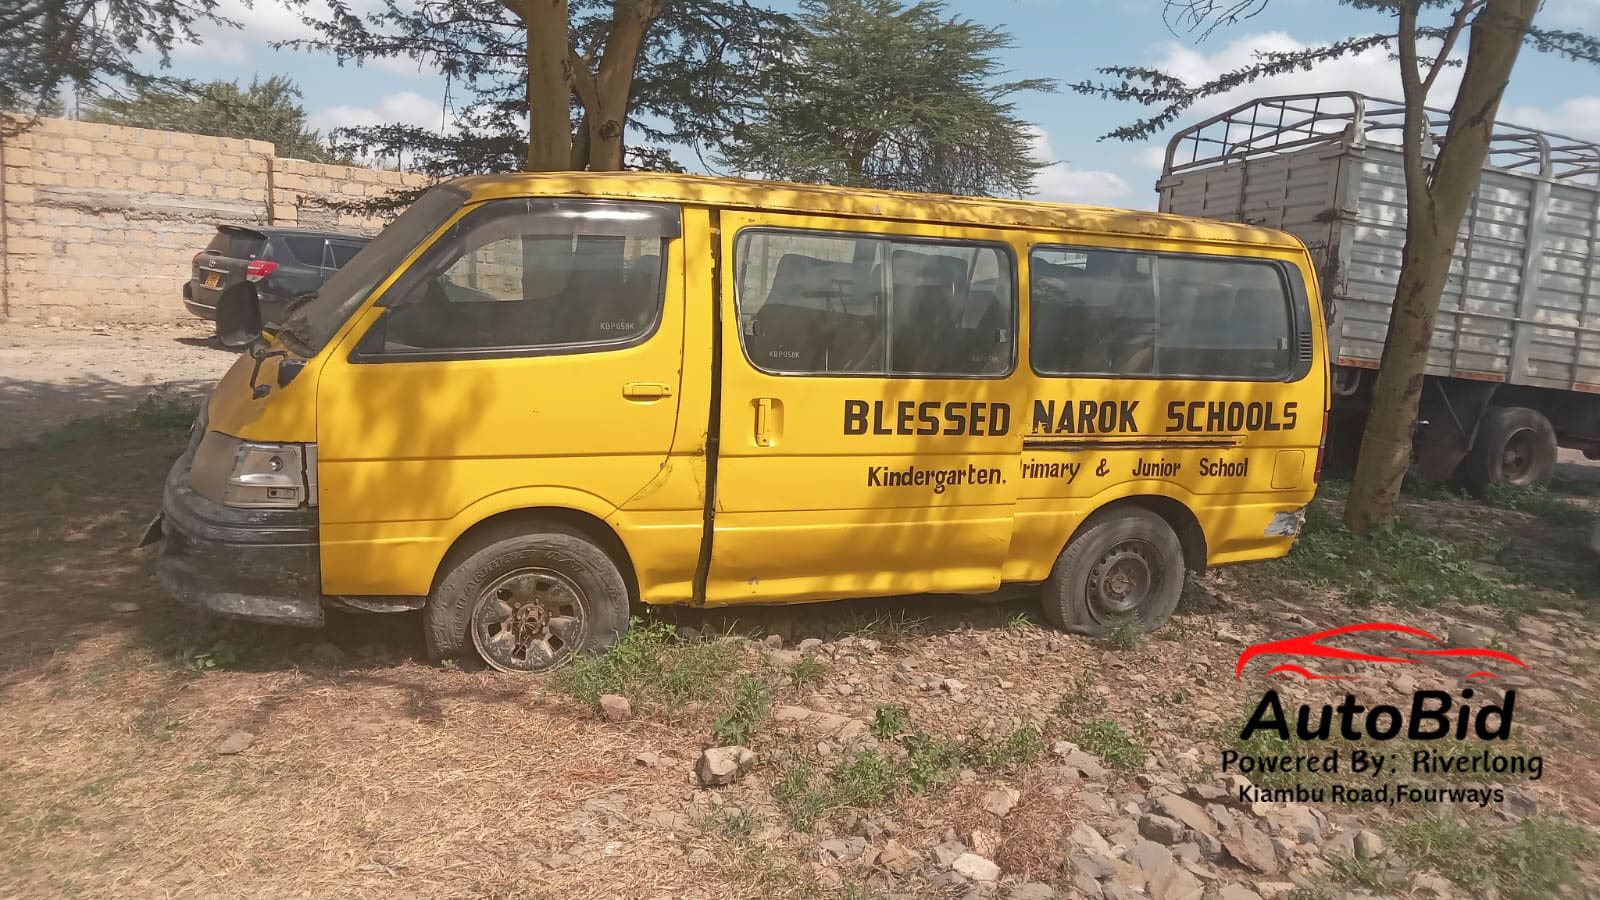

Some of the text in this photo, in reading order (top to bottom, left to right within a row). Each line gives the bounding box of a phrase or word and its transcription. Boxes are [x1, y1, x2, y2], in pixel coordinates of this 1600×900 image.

[844, 400, 1298, 436] BLESSED NAROK SCHOOLS
[868, 457, 1248, 494] Kindergarten. rimary & Junior School
